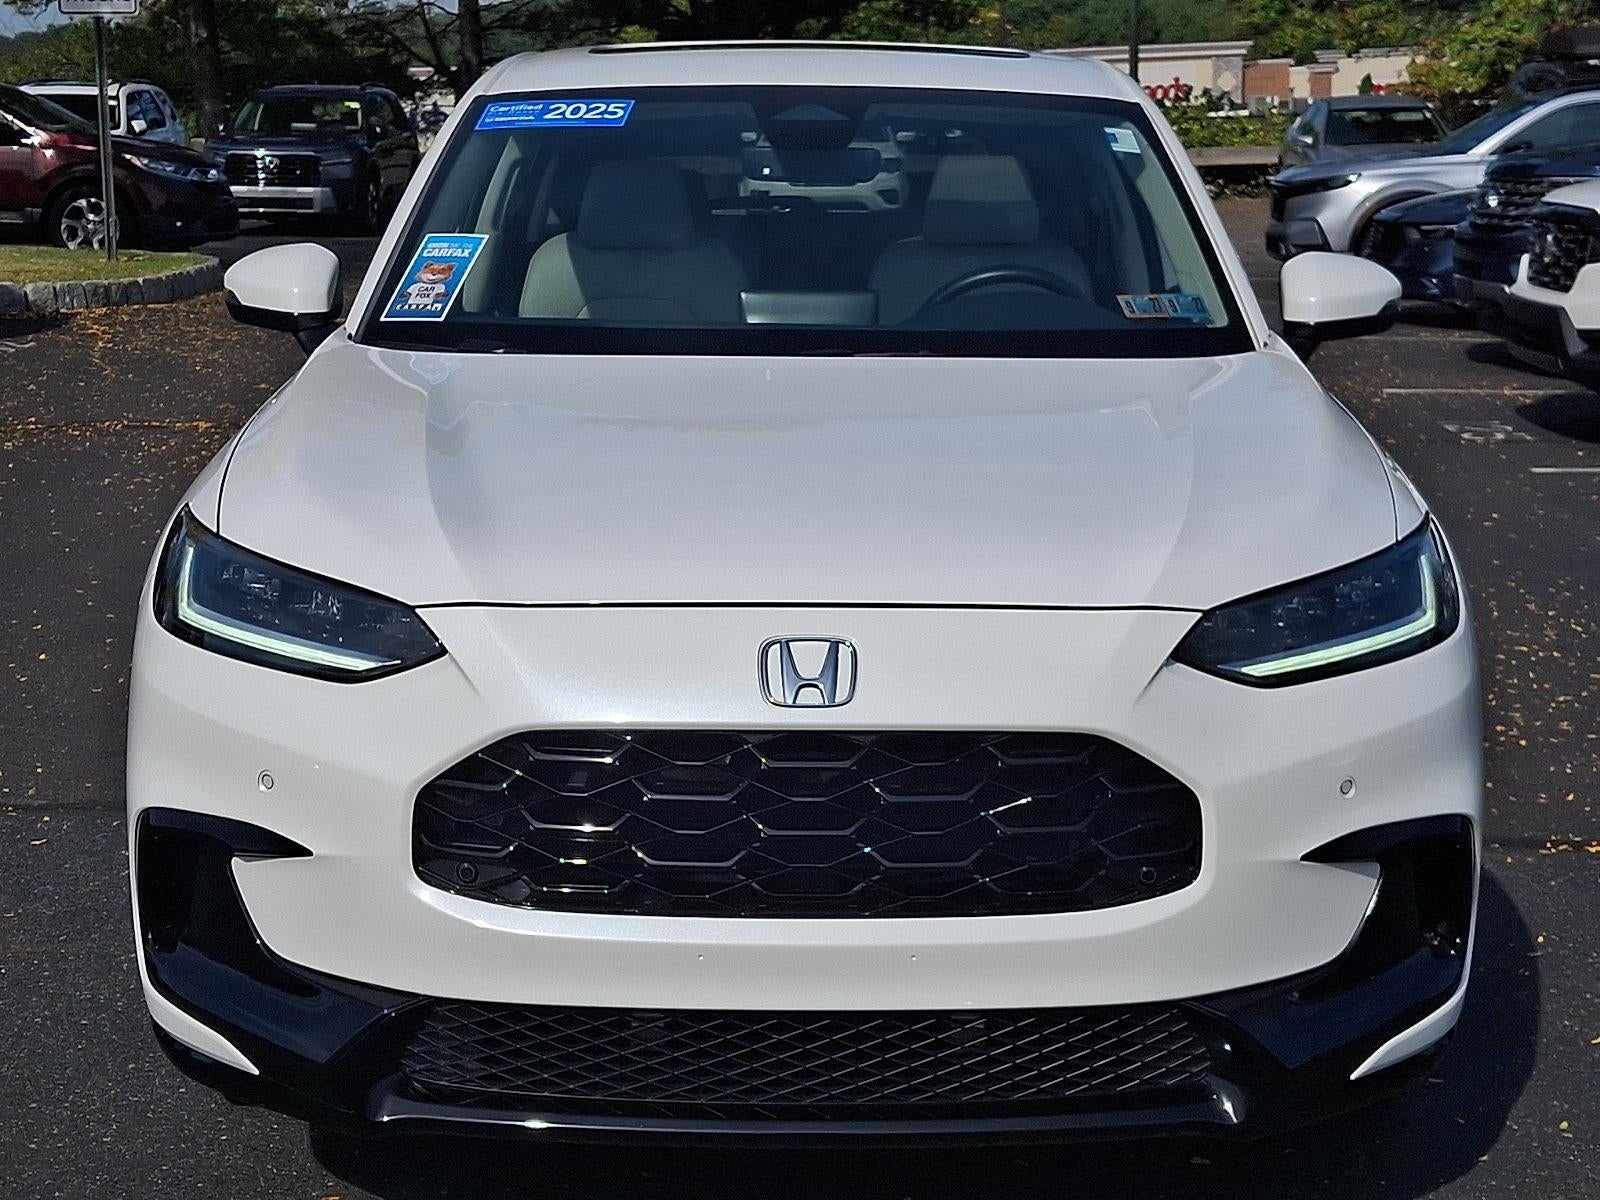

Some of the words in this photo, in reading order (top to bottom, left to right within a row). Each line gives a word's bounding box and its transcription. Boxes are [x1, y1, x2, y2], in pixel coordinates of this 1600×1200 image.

[489, 103, 543, 113] Certified
[543, 103, 627, 119] 2025
[422, 248, 473, 258] CARFAX
